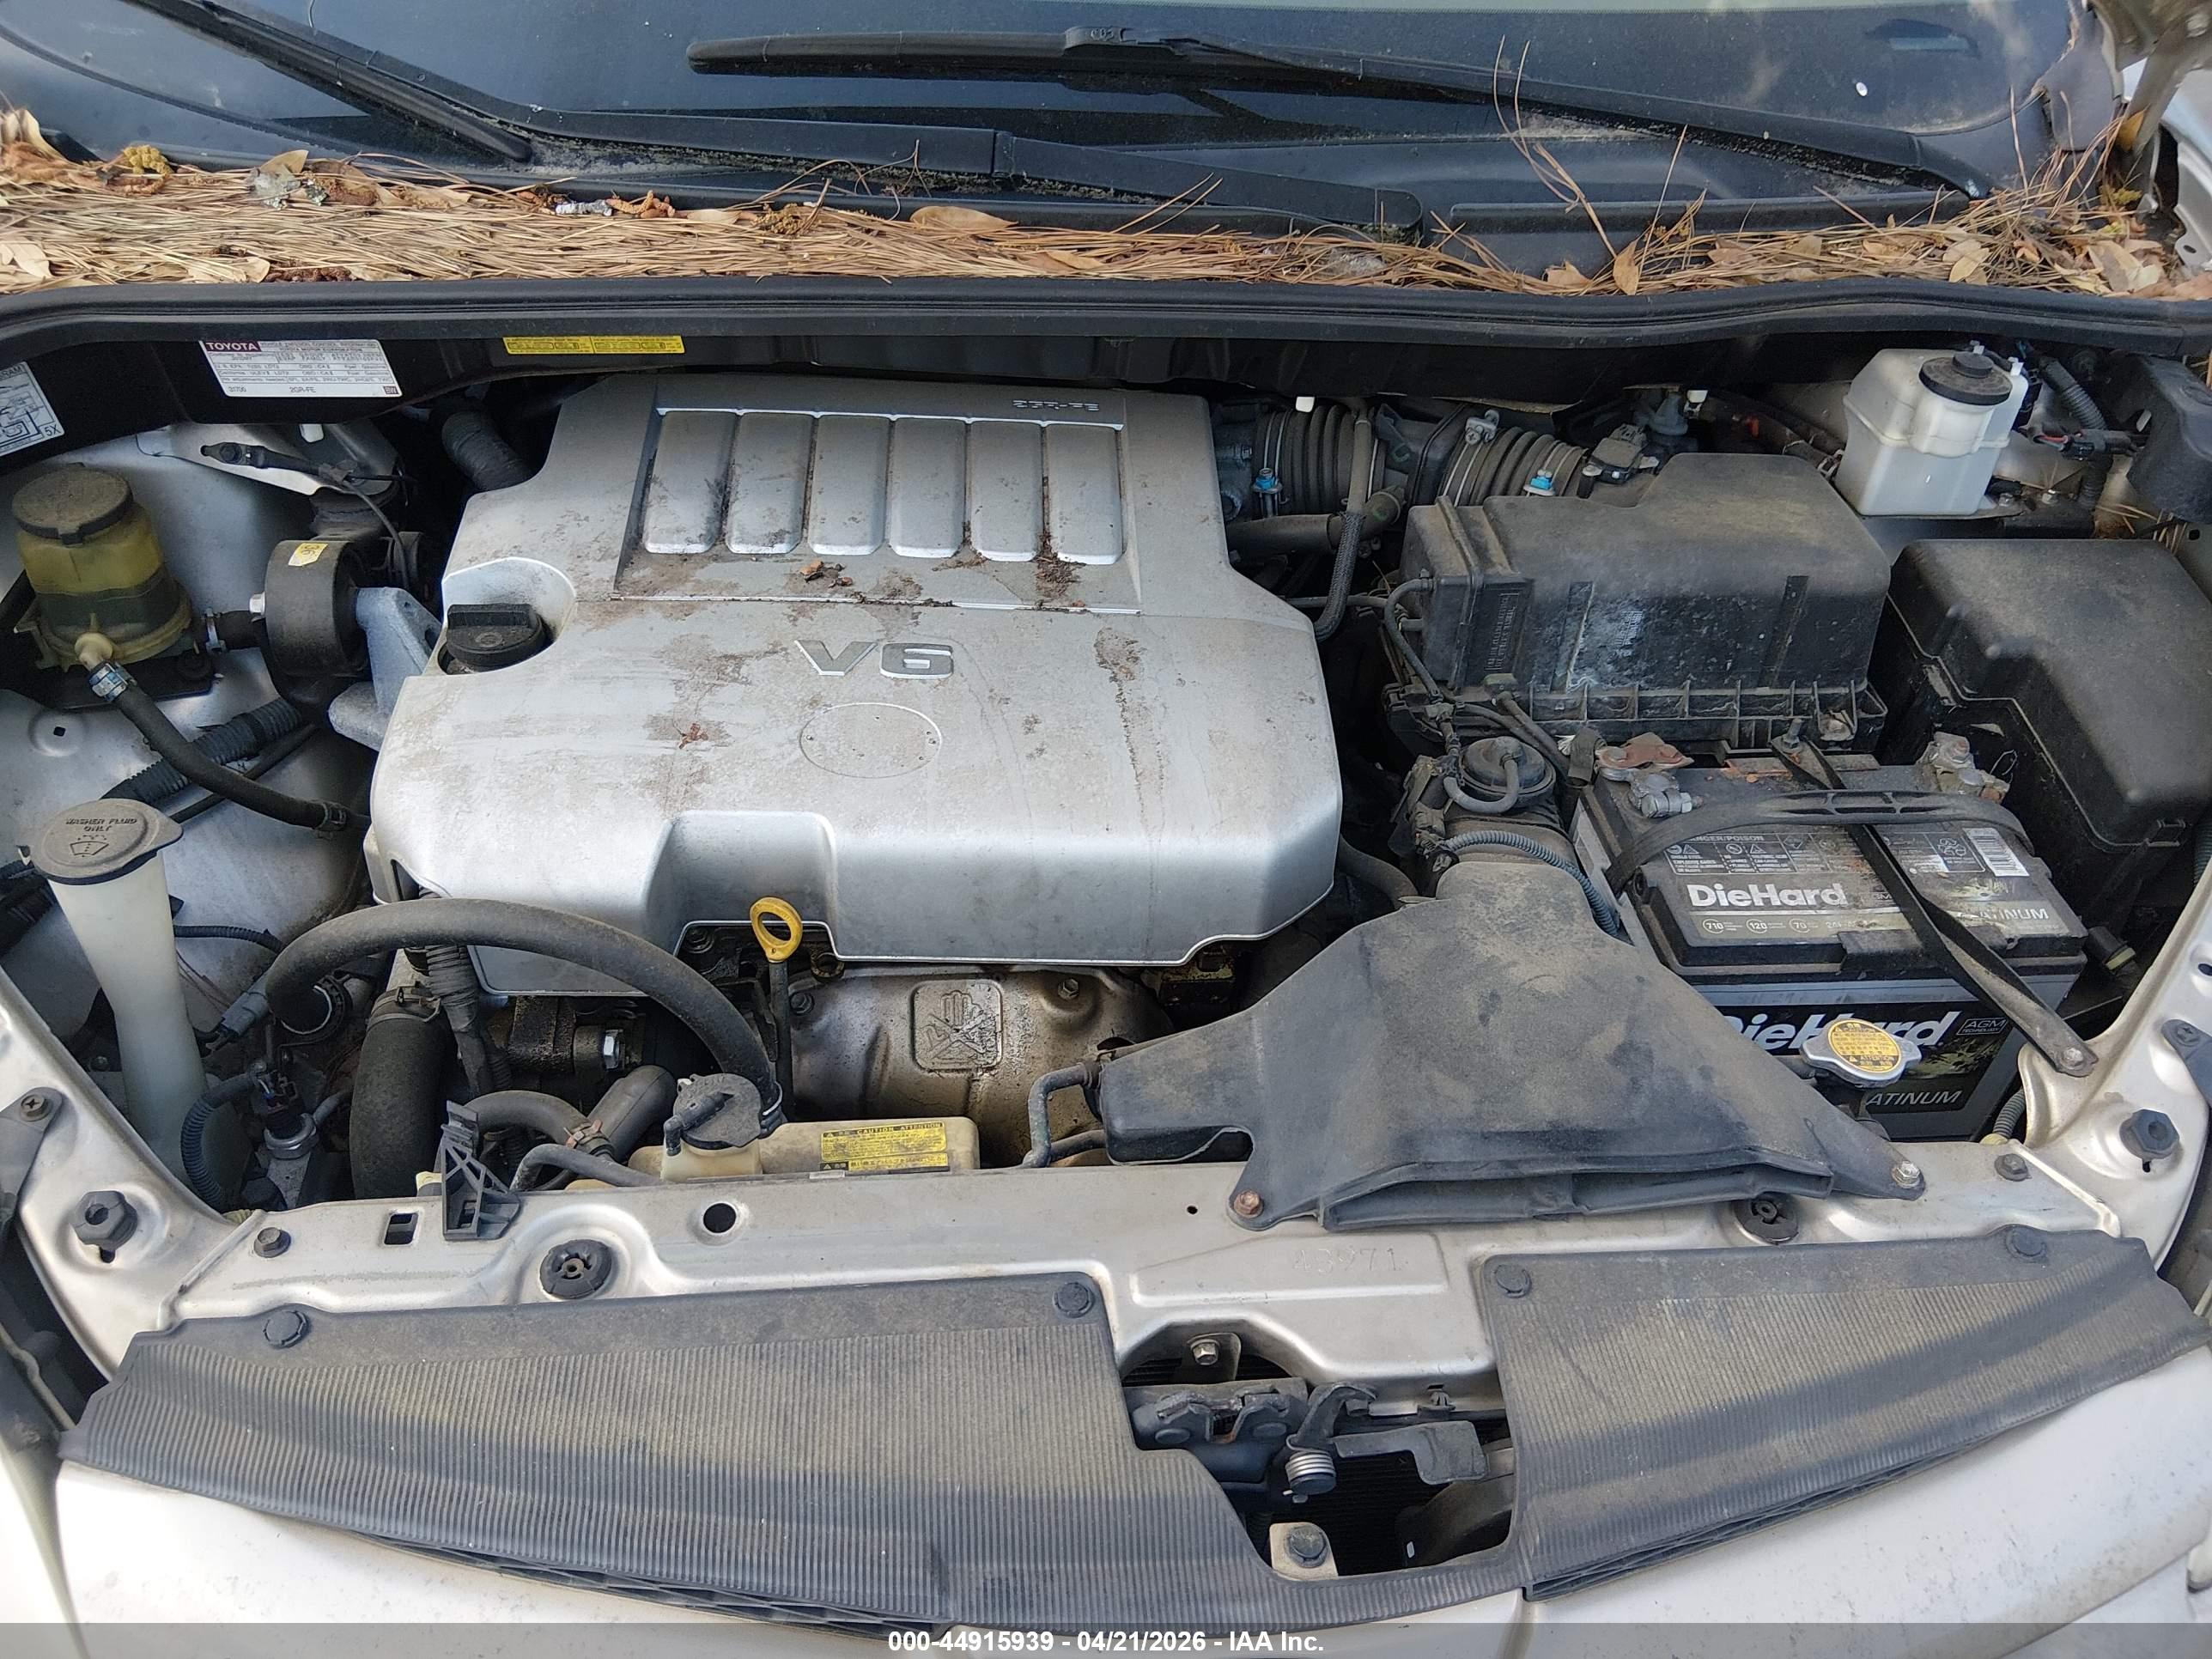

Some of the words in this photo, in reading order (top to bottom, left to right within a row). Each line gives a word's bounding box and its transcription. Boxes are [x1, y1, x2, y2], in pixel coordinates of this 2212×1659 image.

[205, 342, 258, 351] TOYOTA
[794, 640, 955, 680] V6
[1686, 883, 1849, 907] DieHard
[1978, 908, 2049, 920] ATINUM
[1723, 1012, 1962, 1050] ieHrd
[1964, 1018, 2003, 1028] AGM
[1866, 1091, 1963, 1106] ATINUM
[901, 1122, 941, 1131] ATTENTION
